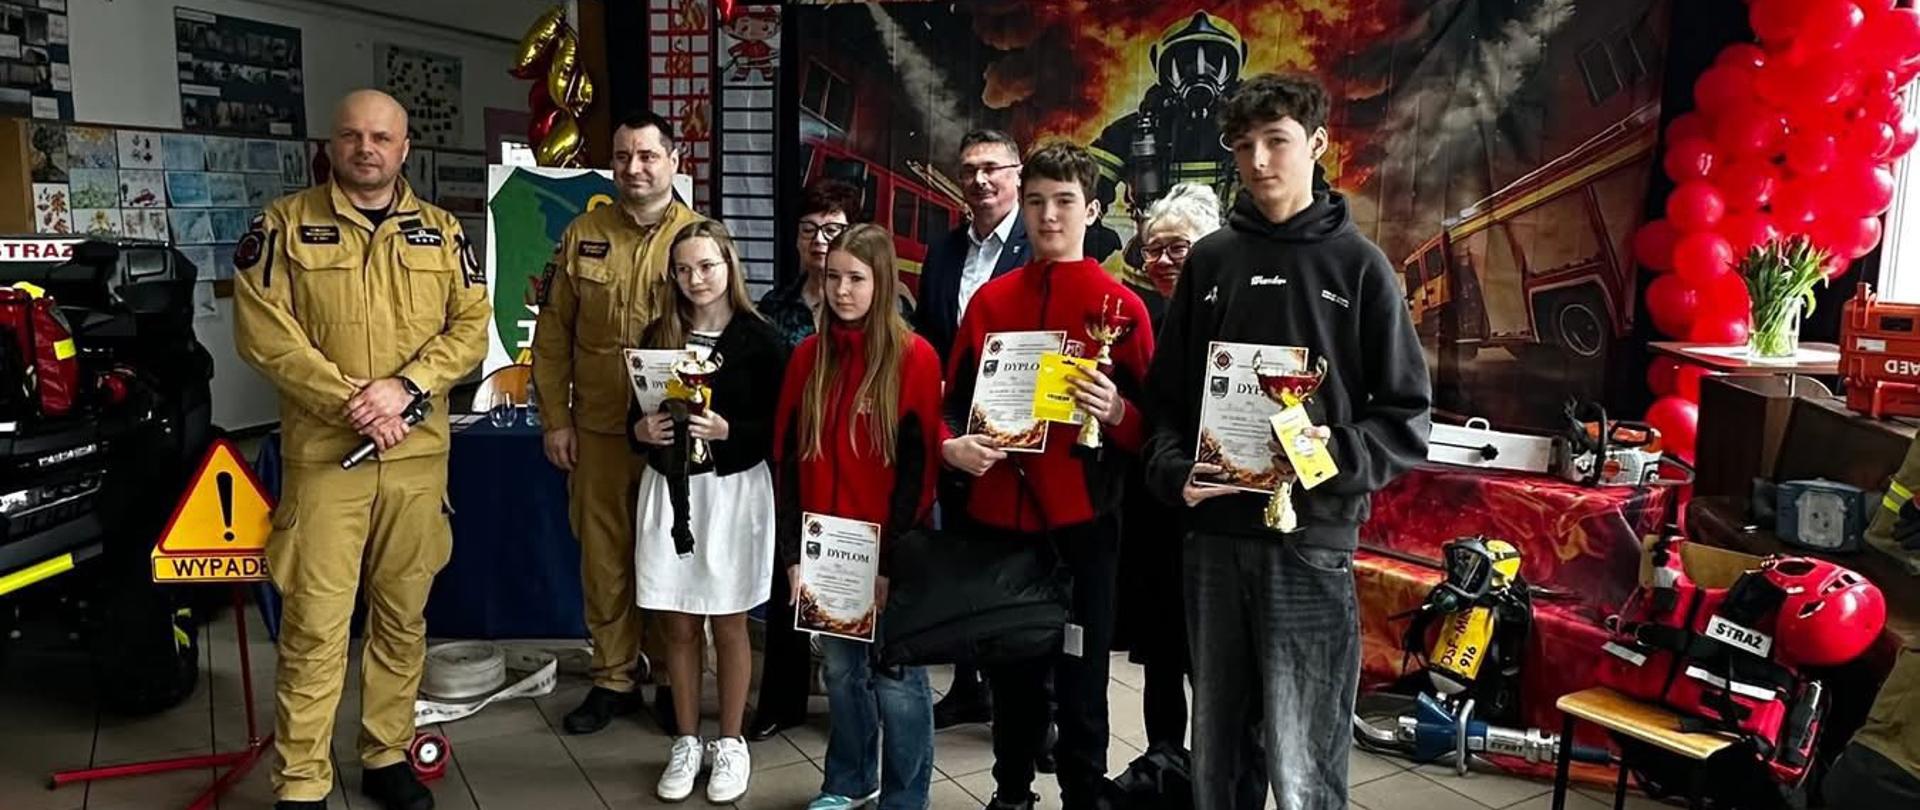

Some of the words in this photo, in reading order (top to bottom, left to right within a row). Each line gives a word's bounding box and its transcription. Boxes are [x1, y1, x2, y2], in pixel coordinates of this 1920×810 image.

[1003, 361, 1040, 373] DYPLO
[1884, 359, 1920, 376] AED
[827, 548, 870, 563] DYPLOM
[171, 557, 269, 577] WYPADE
[1460, 646, 1477, 667] 916
